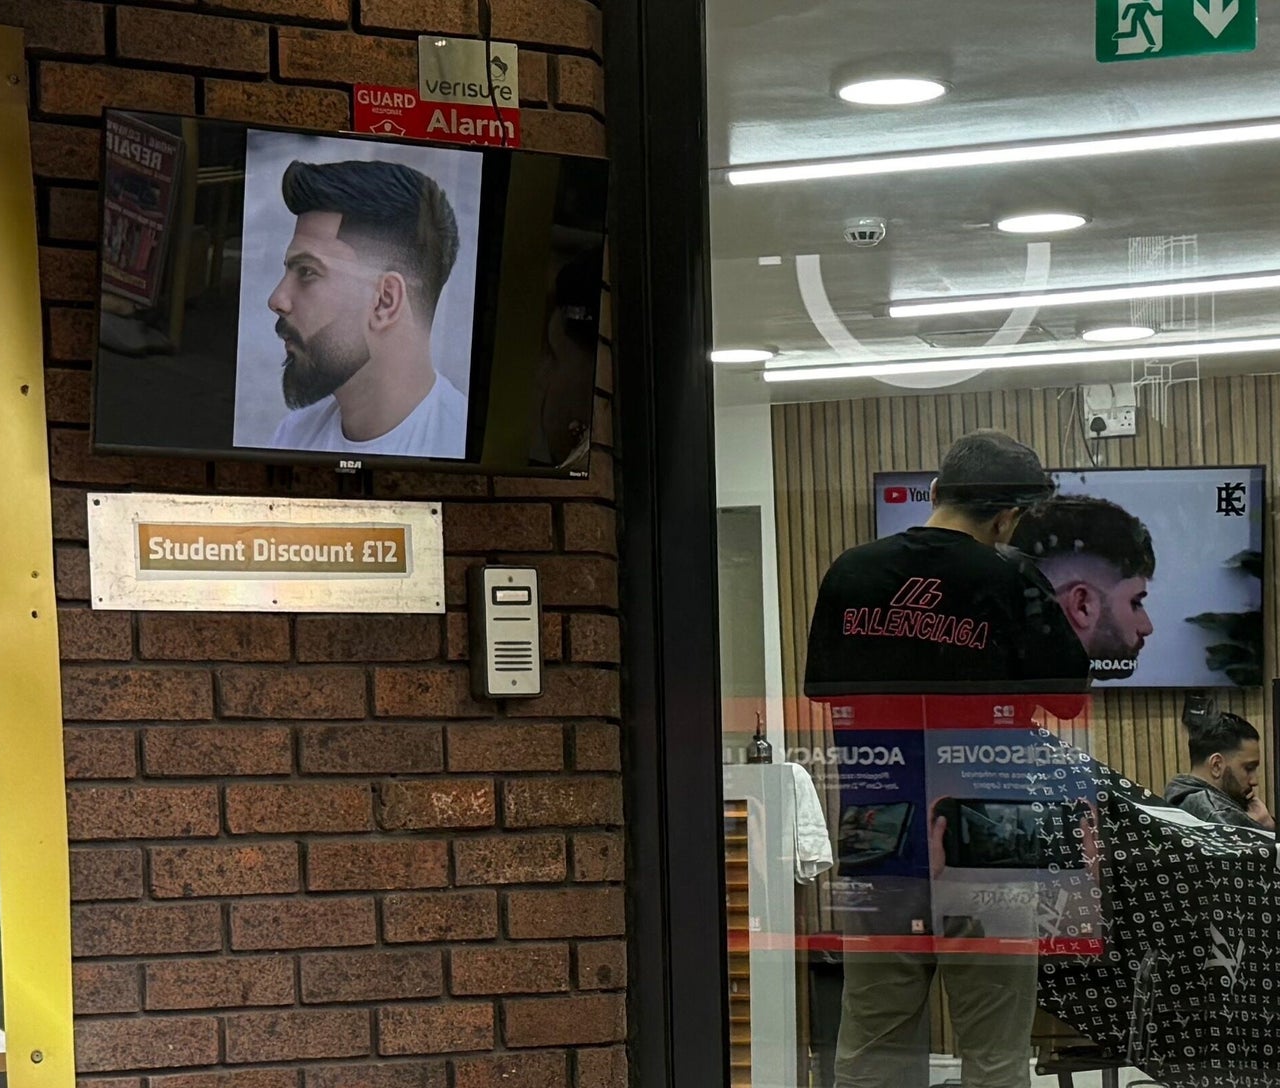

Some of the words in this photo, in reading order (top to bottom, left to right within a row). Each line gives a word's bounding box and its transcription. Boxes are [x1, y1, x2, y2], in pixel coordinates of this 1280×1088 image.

[357, 89, 416, 109] GUARD
[426, 79, 513, 100] verisure
[427, 109, 515, 138] Alarm
[339, 460, 362, 469] RCA
[149, 536, 245, 561] Student
[253, 538, 354, 562] Discount
[362, 541, 398, 563] £12
[843, 607, 989, 649] BALENCIAGA
